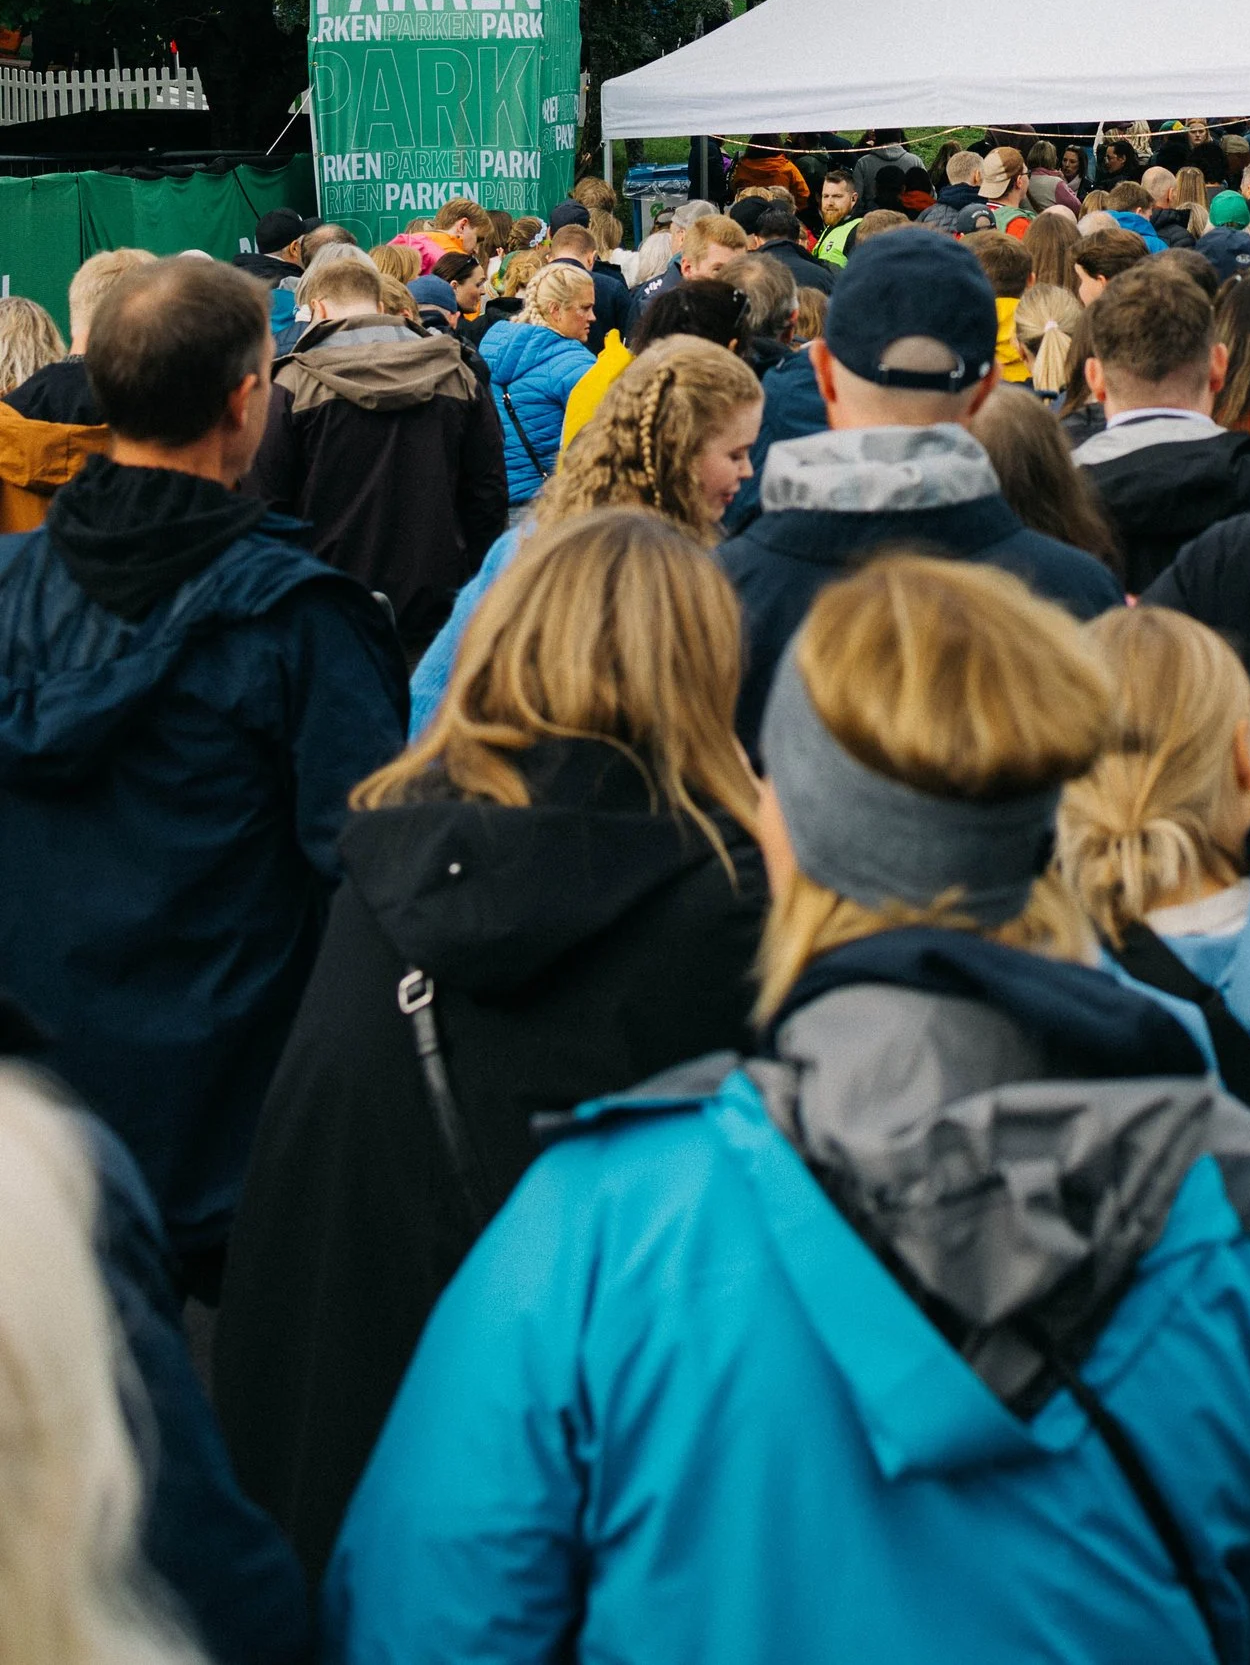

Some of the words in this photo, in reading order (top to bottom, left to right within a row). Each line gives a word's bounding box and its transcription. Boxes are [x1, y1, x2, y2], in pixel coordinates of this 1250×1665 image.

[317, 15, 381, 42] RKEN
[383, 13, 480, 41] PARKEN
[482, 12, 544, 38] PARK
[315, 45, 542, 151] PARK
[323, 152, 381, 183] RKEN
[383, 150, 477, 179] PARKEN
[480, 150, 541, 179] PARK
[325, 183, 383, 214] RKEN
[385, 181, 479, 211] PARKEN
[480, 181, 540, 211] PARK
